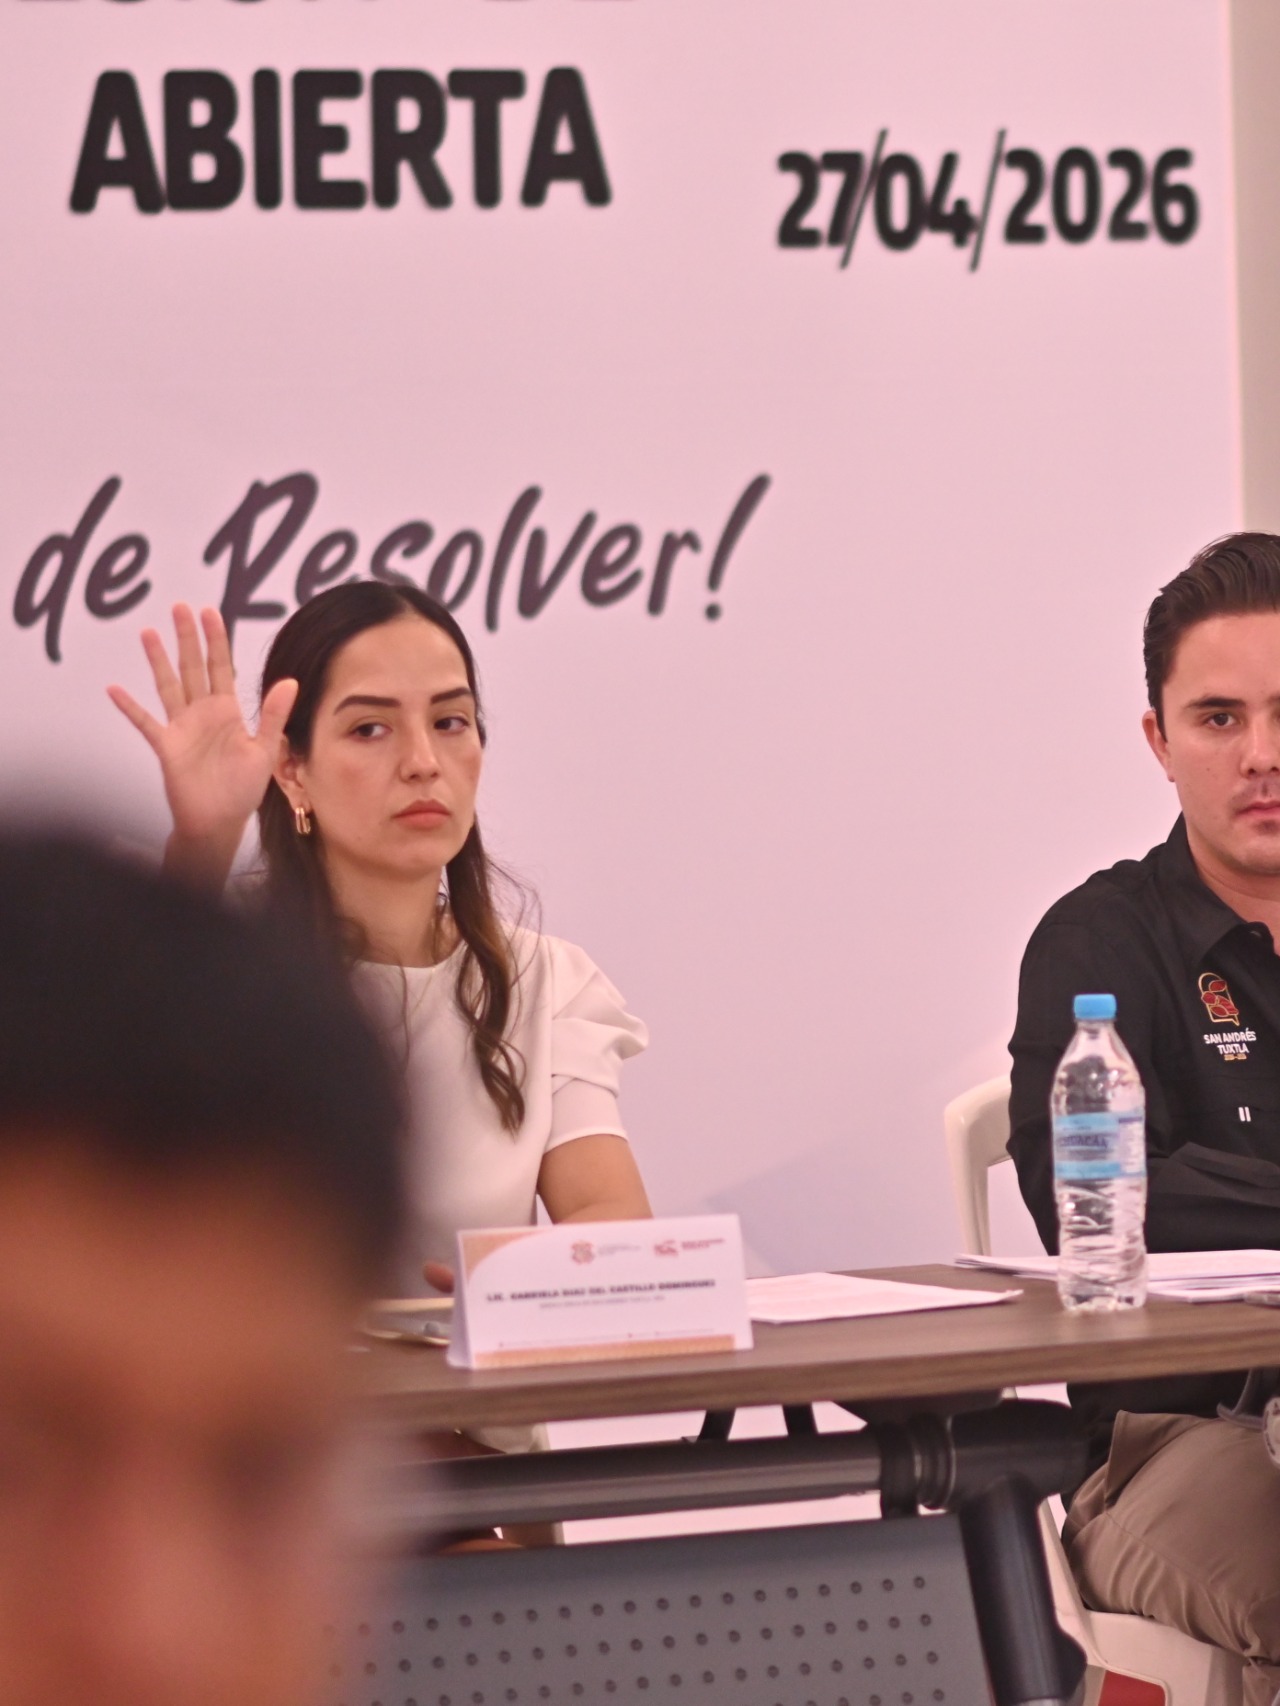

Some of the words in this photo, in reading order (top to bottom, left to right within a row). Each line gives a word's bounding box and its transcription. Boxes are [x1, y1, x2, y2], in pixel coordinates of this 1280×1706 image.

[68, 66, 613, 214] ABIERTA
[776, 127, 1201, 272] 27/04/2026
[12, 474, 152, 664] de
[203, 470, 772, 664] Resolver!
[1203, 1033, 1223, 1045] SAN
[1222, 1027, 1257, 1043] ANDRÉS
[1217, 1042, 1250, 1055] TUXTLA
